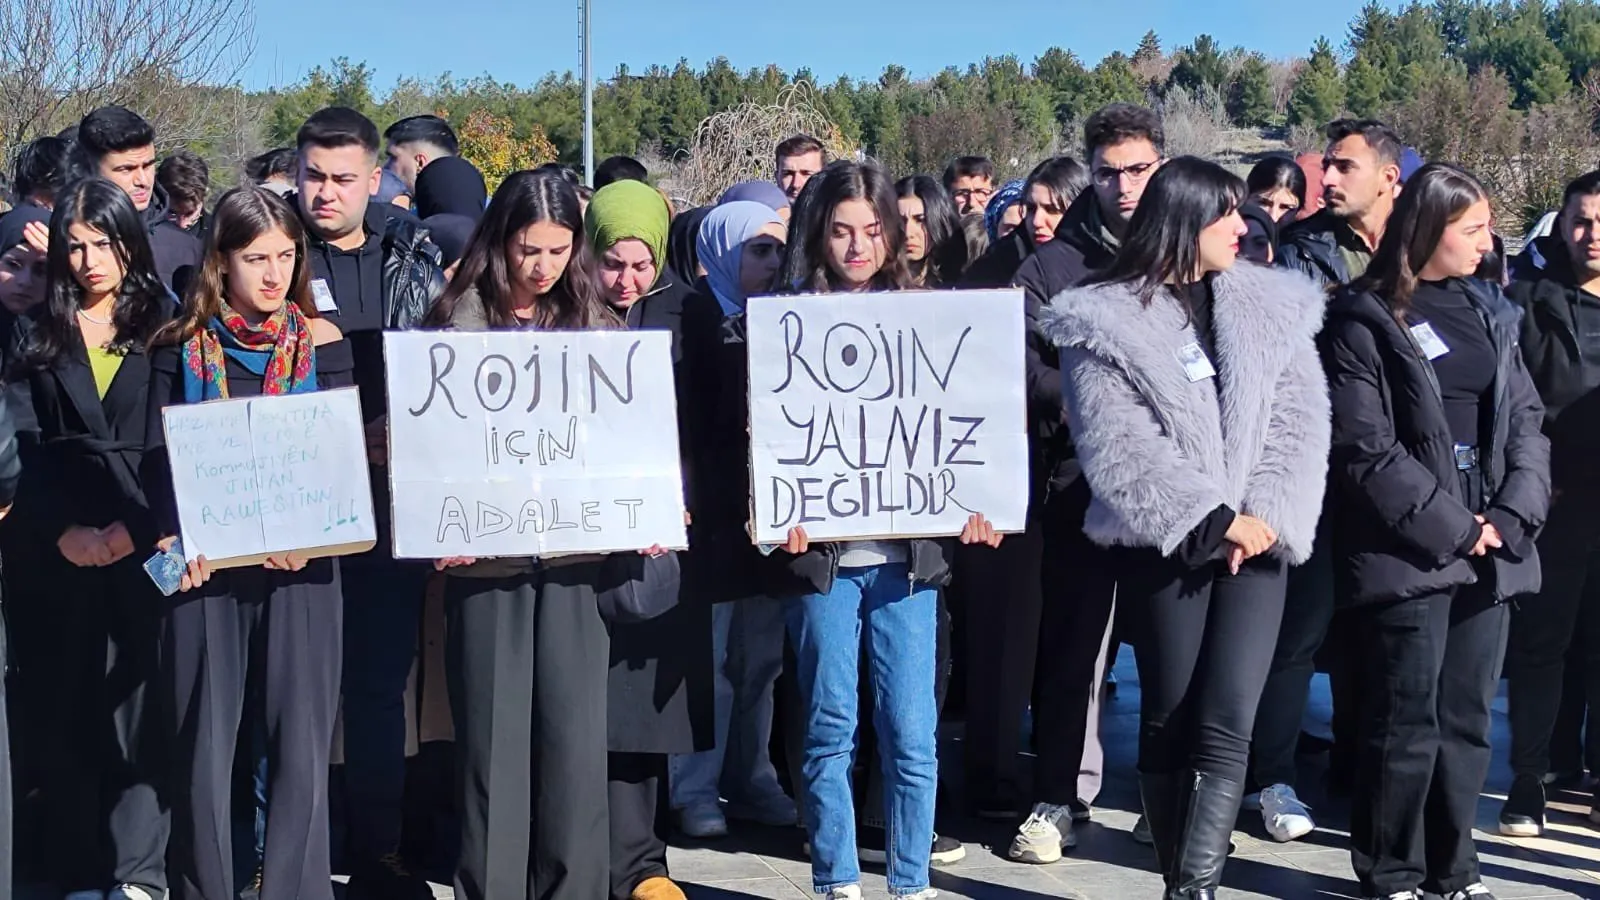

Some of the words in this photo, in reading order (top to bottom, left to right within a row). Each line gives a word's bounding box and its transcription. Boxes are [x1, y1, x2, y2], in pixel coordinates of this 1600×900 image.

[490, 415, 577, 466] İÇİN
[777, 401, 986, 470] YALNIZ
[436, 495, 644, 544] ADALET
